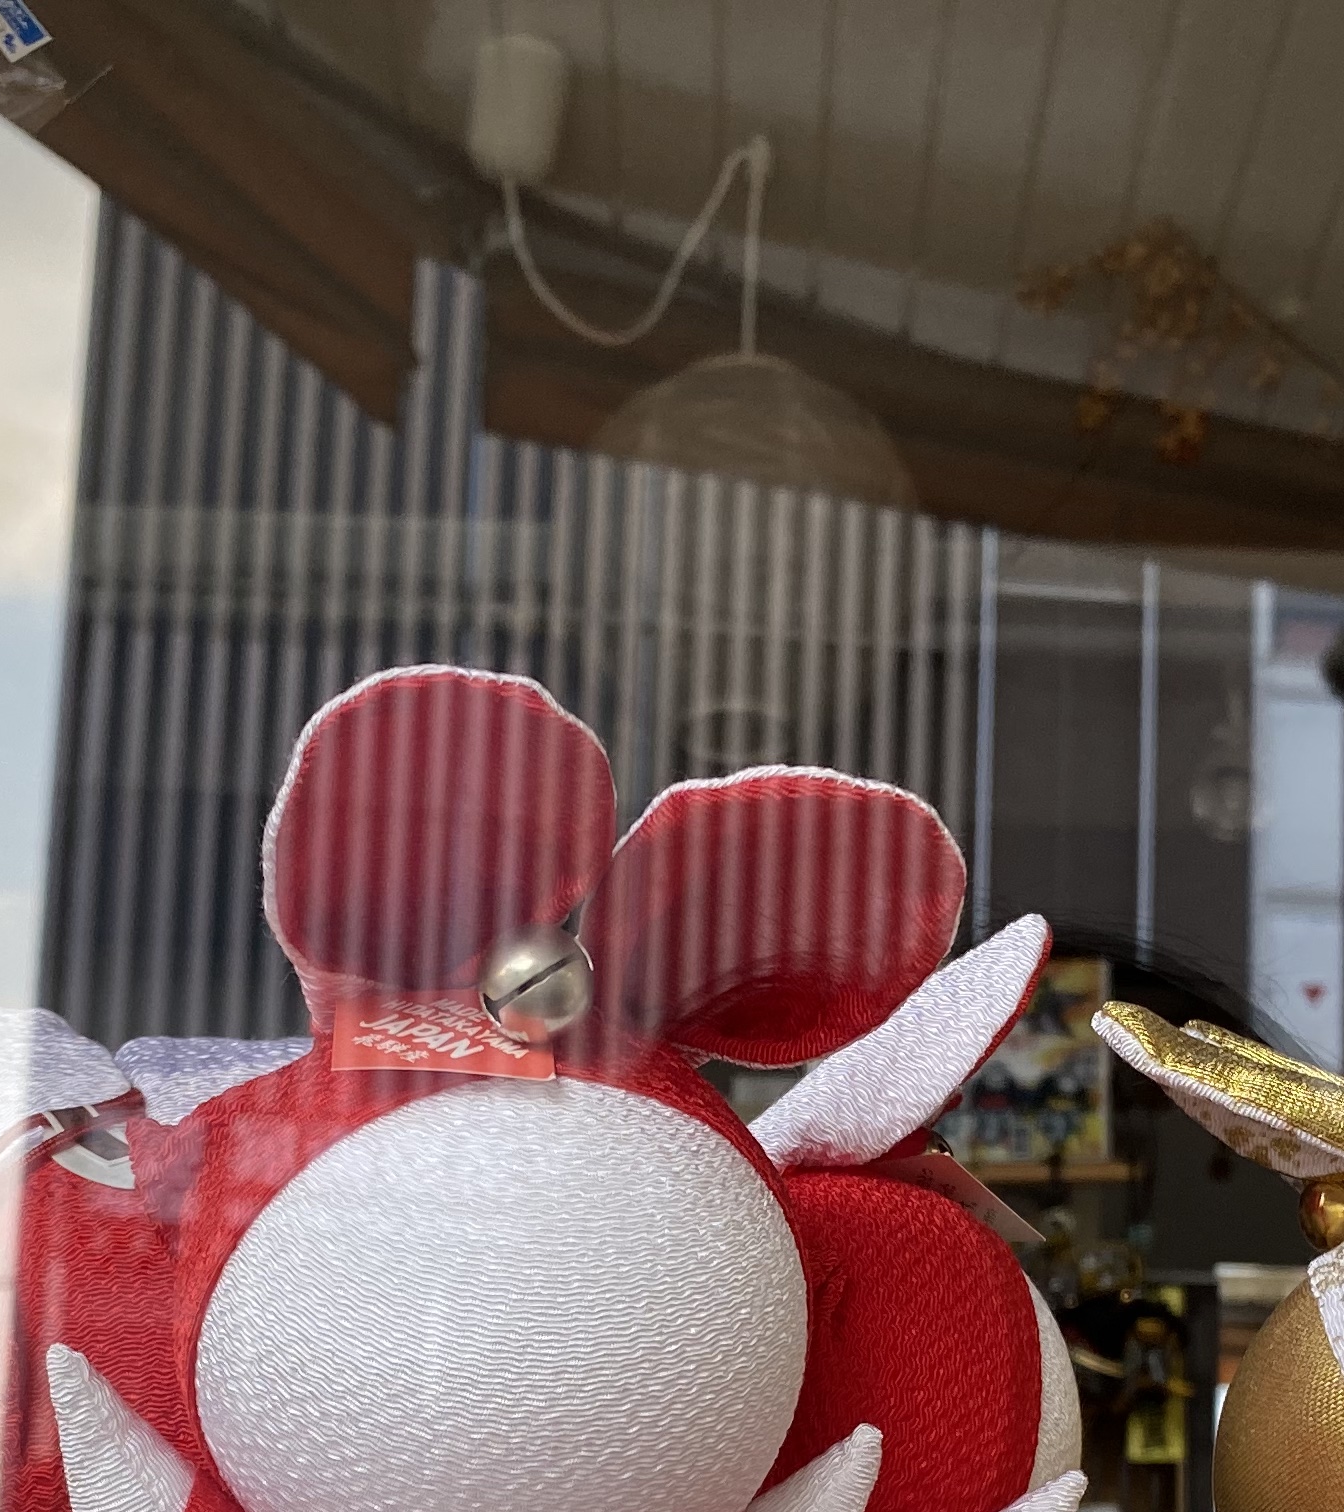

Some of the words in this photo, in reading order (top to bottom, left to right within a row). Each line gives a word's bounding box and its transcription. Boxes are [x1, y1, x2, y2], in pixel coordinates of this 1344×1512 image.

[380, 999, 530, 1060] HIDATAKAYAMA
[432, 998, 487, 1023] MADE
[359, 1013, 485, 1059] JAPAN
